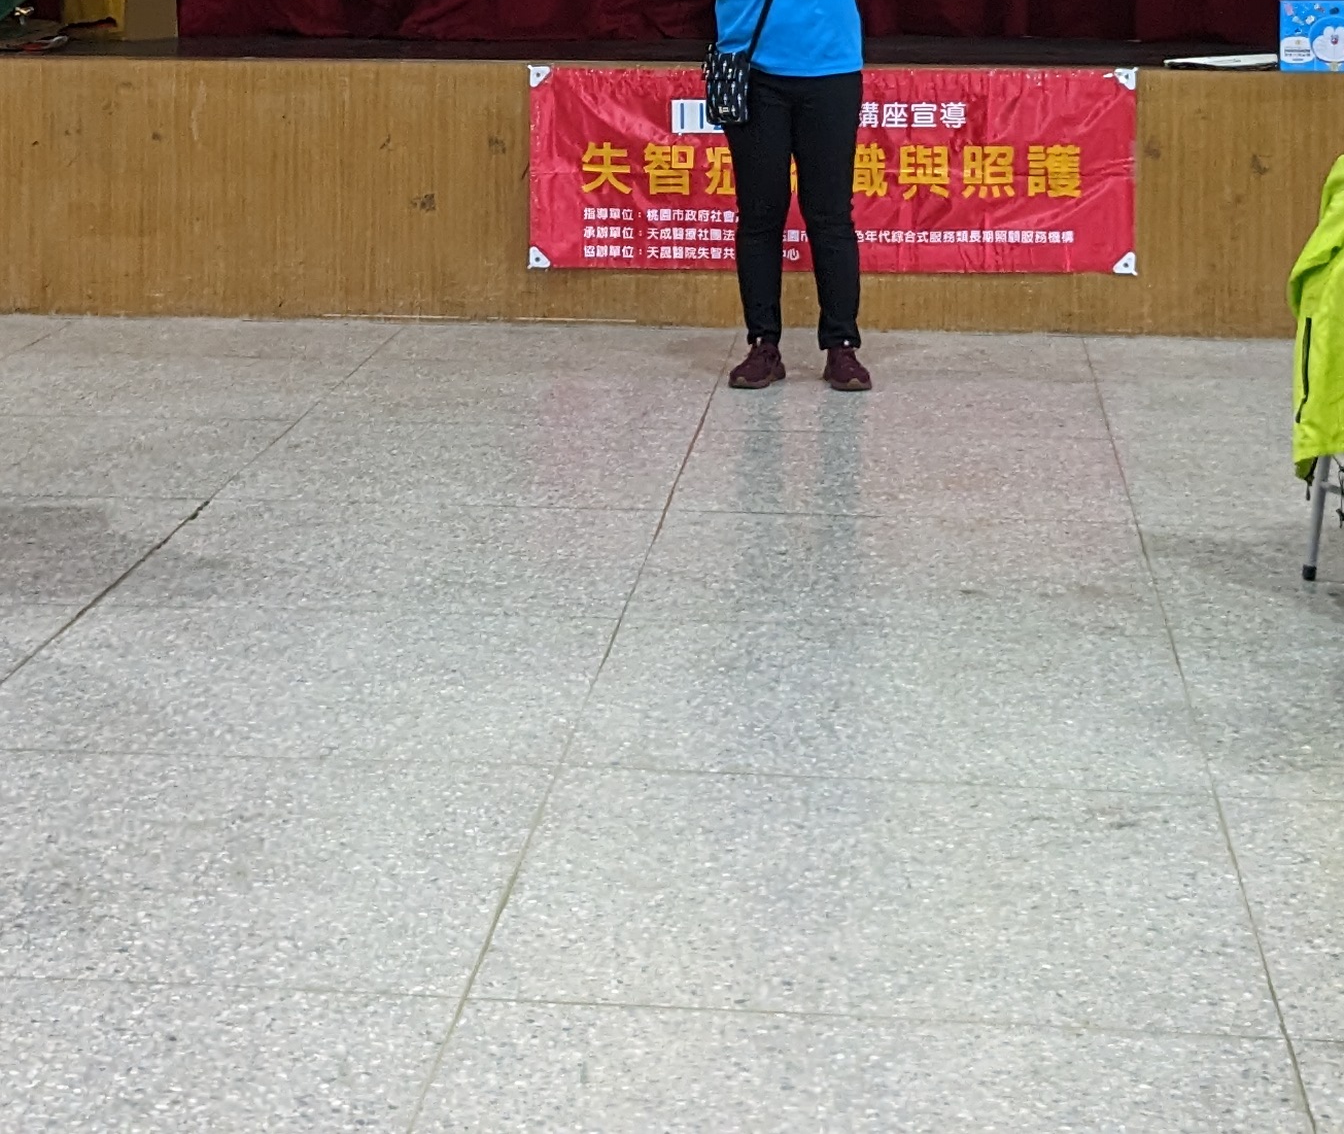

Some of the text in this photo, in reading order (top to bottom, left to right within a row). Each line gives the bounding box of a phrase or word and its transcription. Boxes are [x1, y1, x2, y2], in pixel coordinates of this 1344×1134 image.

[583, 207, 738, 224] 指導單位：桃園市政府社會
